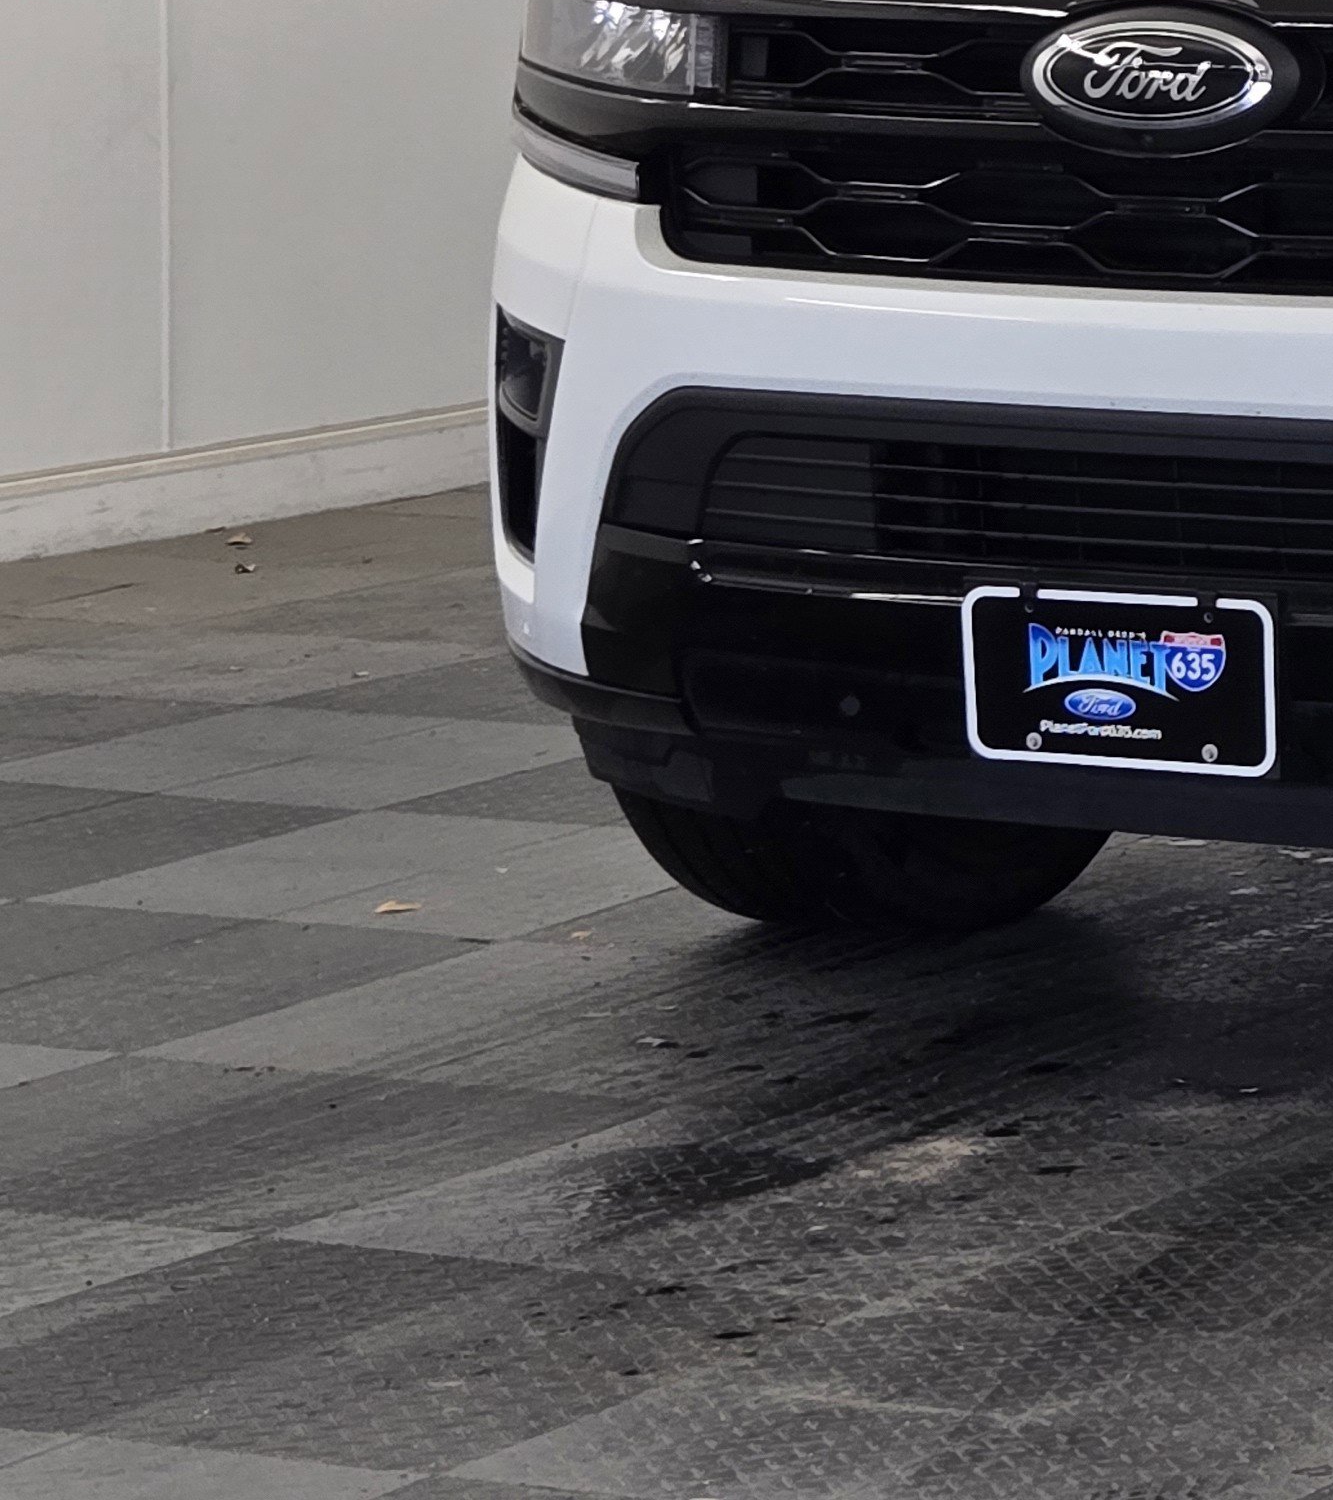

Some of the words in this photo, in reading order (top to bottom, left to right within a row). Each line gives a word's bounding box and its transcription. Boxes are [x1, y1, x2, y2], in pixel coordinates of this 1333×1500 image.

[1083, 41, 1208, 103] Ford
[1028, 622, 1171, 693] PLANET
[1171, 652, 1216, 681] 635
